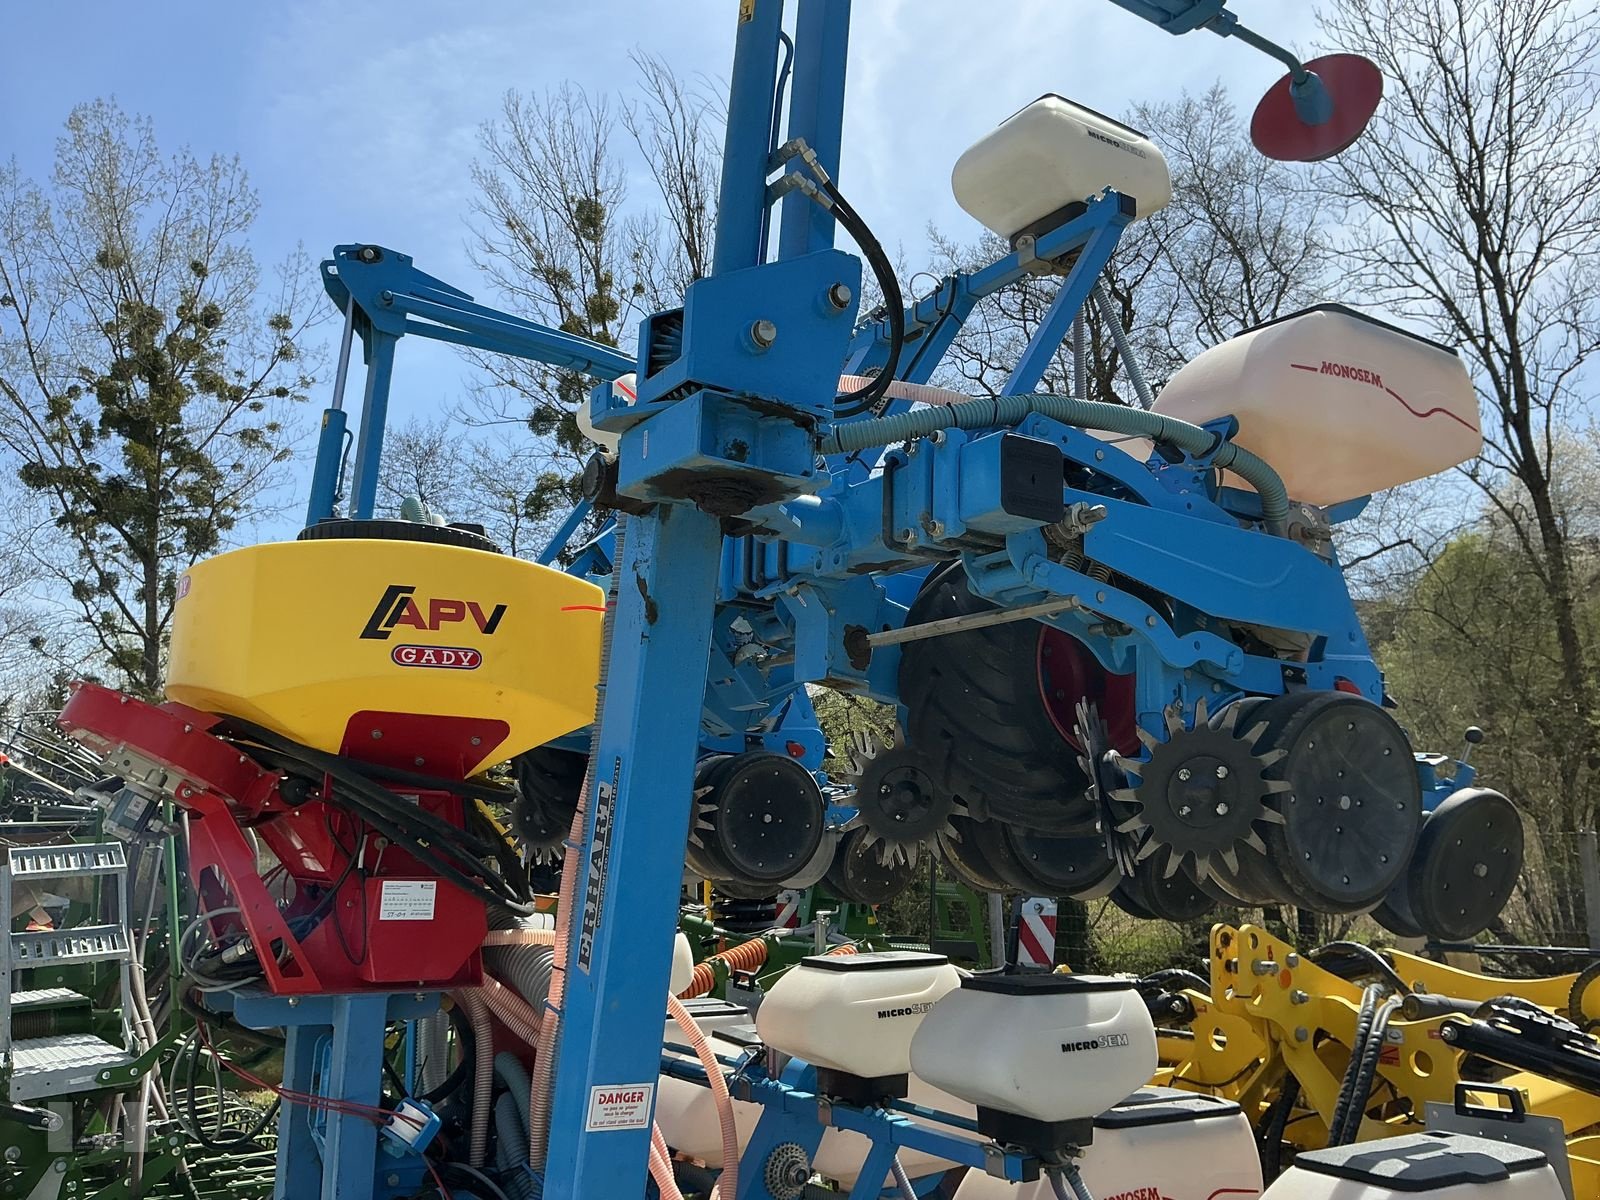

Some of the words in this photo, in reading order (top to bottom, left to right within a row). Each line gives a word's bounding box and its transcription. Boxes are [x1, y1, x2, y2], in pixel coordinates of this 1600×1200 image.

[1320, 361, 1384, 389] MONOSEM
[384, 596, 508, 635] APV
[401, 648, 474, 666] GADY
[578, 786, 611, 970] ERHART
[1061, 1034, 1128, 1053] MICROSEM
[599, 1092, 644, 1104] DANGER
